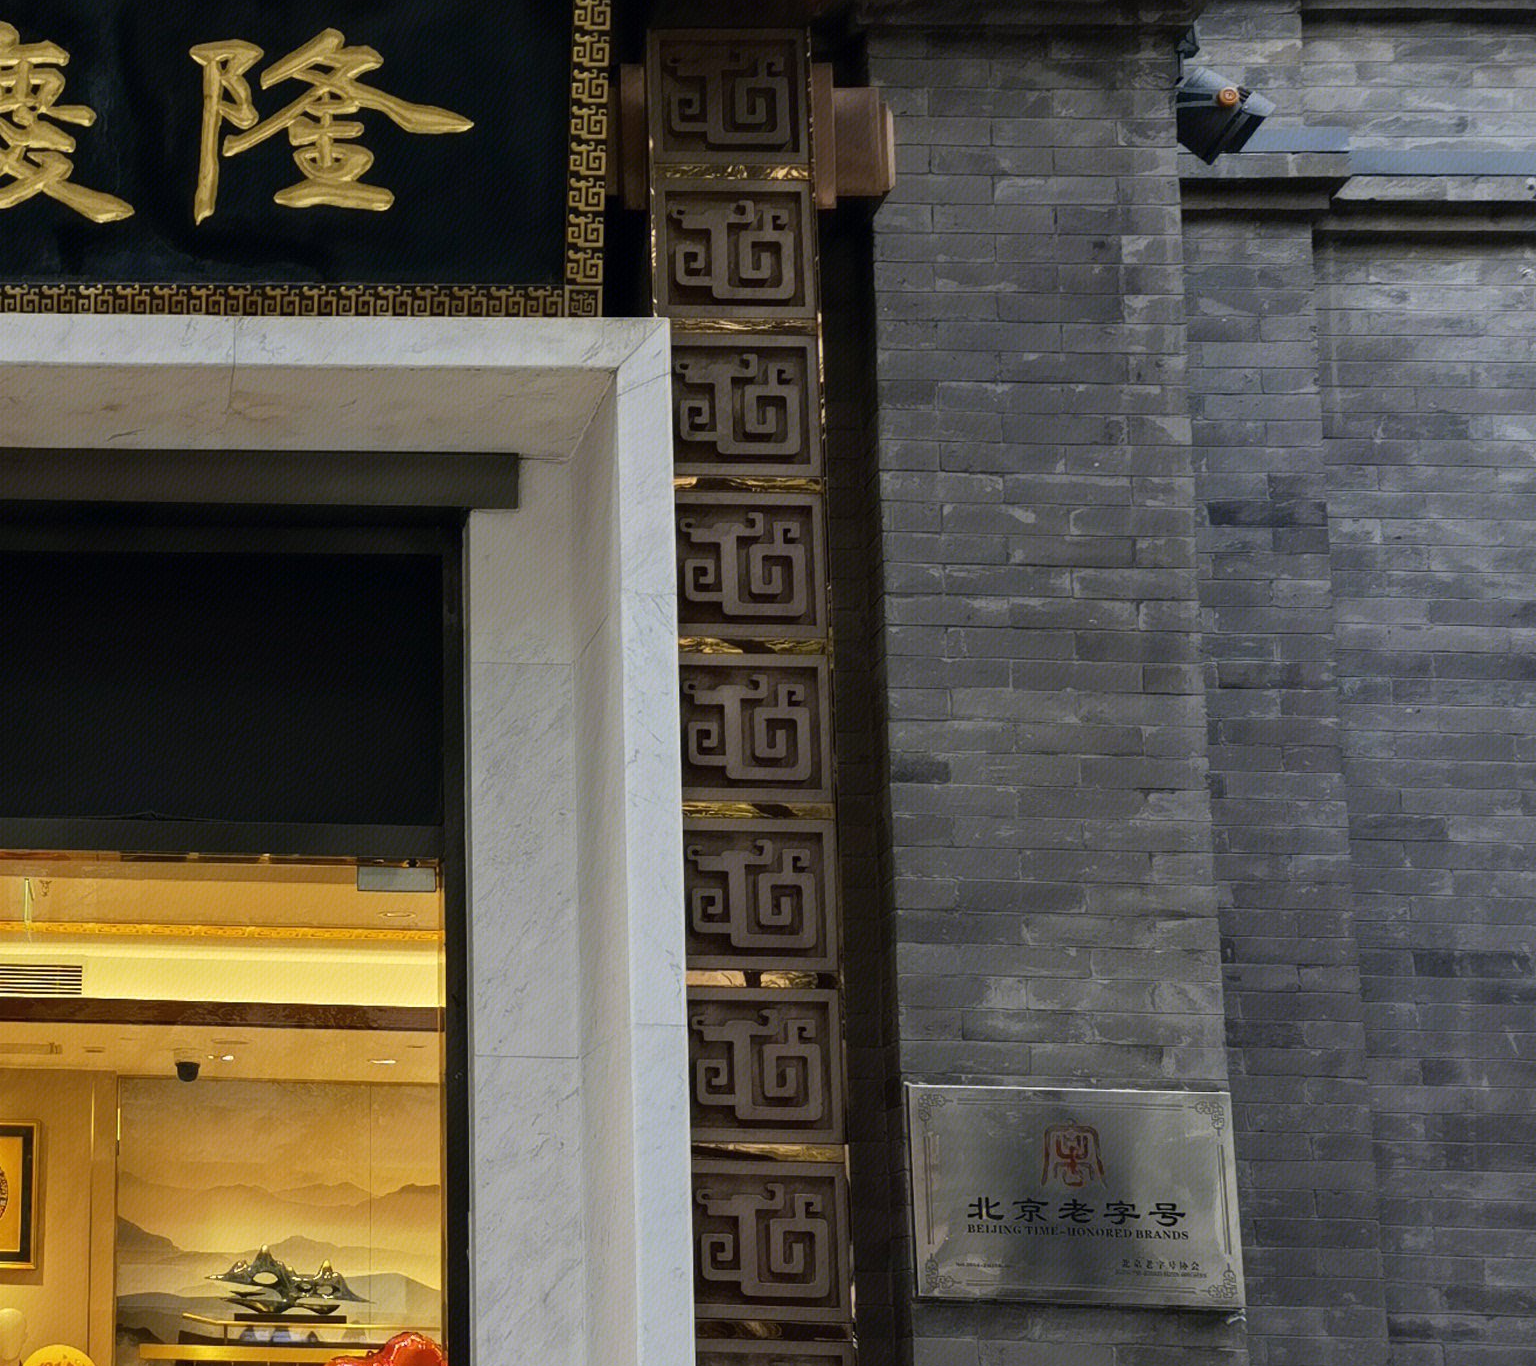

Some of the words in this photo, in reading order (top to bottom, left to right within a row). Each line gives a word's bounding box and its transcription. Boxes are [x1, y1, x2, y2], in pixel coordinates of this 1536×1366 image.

[967, 1196, 1187, 1227] 北京老字号
[967, 1223, 1022, 1236] BEIJING
[1026, 1225, 1132, 1239] TIME-HONORED
[1135, 1228, 1189, 1240] BRANDS
